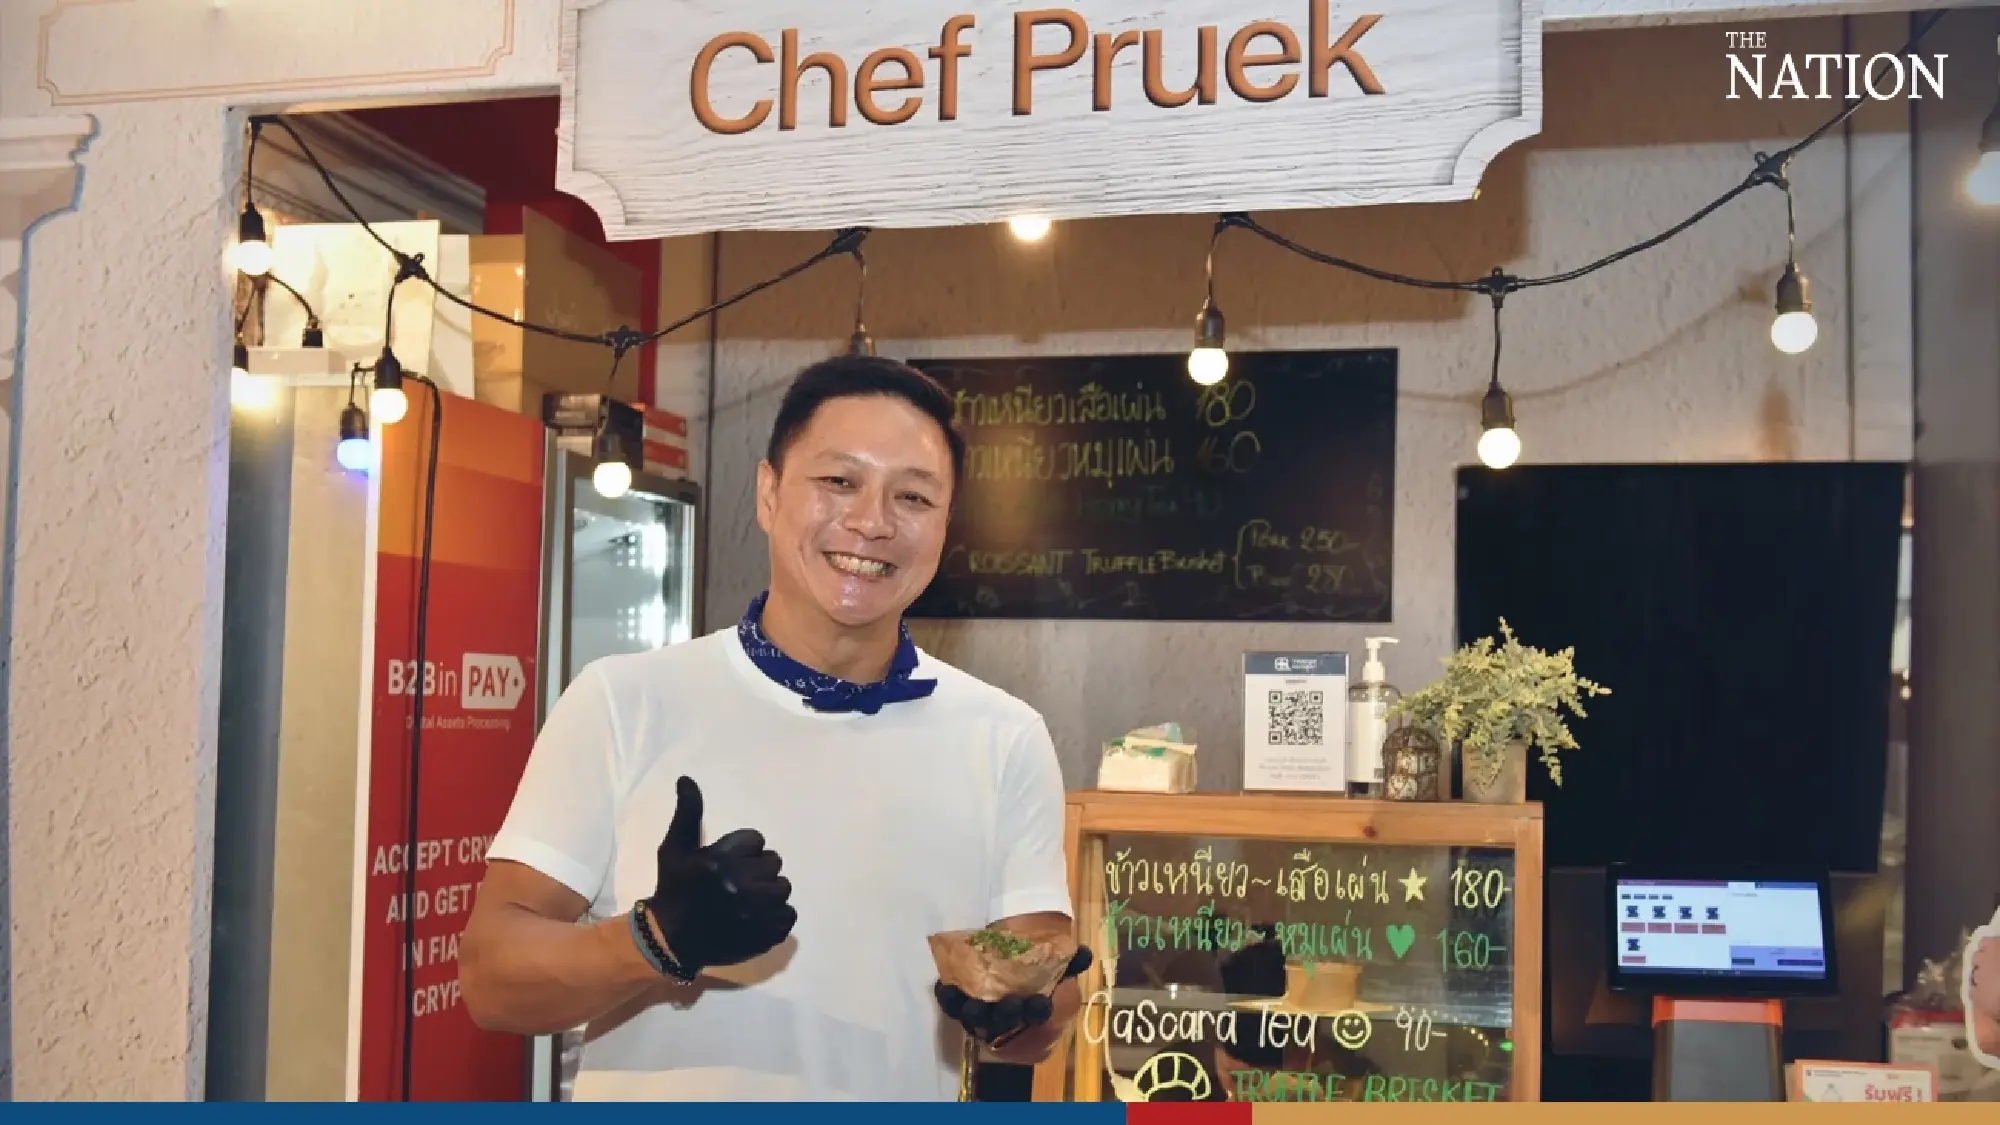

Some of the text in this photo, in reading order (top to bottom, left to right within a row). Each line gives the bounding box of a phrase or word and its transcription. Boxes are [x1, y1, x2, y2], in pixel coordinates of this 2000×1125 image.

[690, 0, 1386, 134] Chef Pruek
[468, 666, 510, 696] PAY
[434, 884, 472, 915] GET
[1255, 1002, 1318, 1053] Tea
